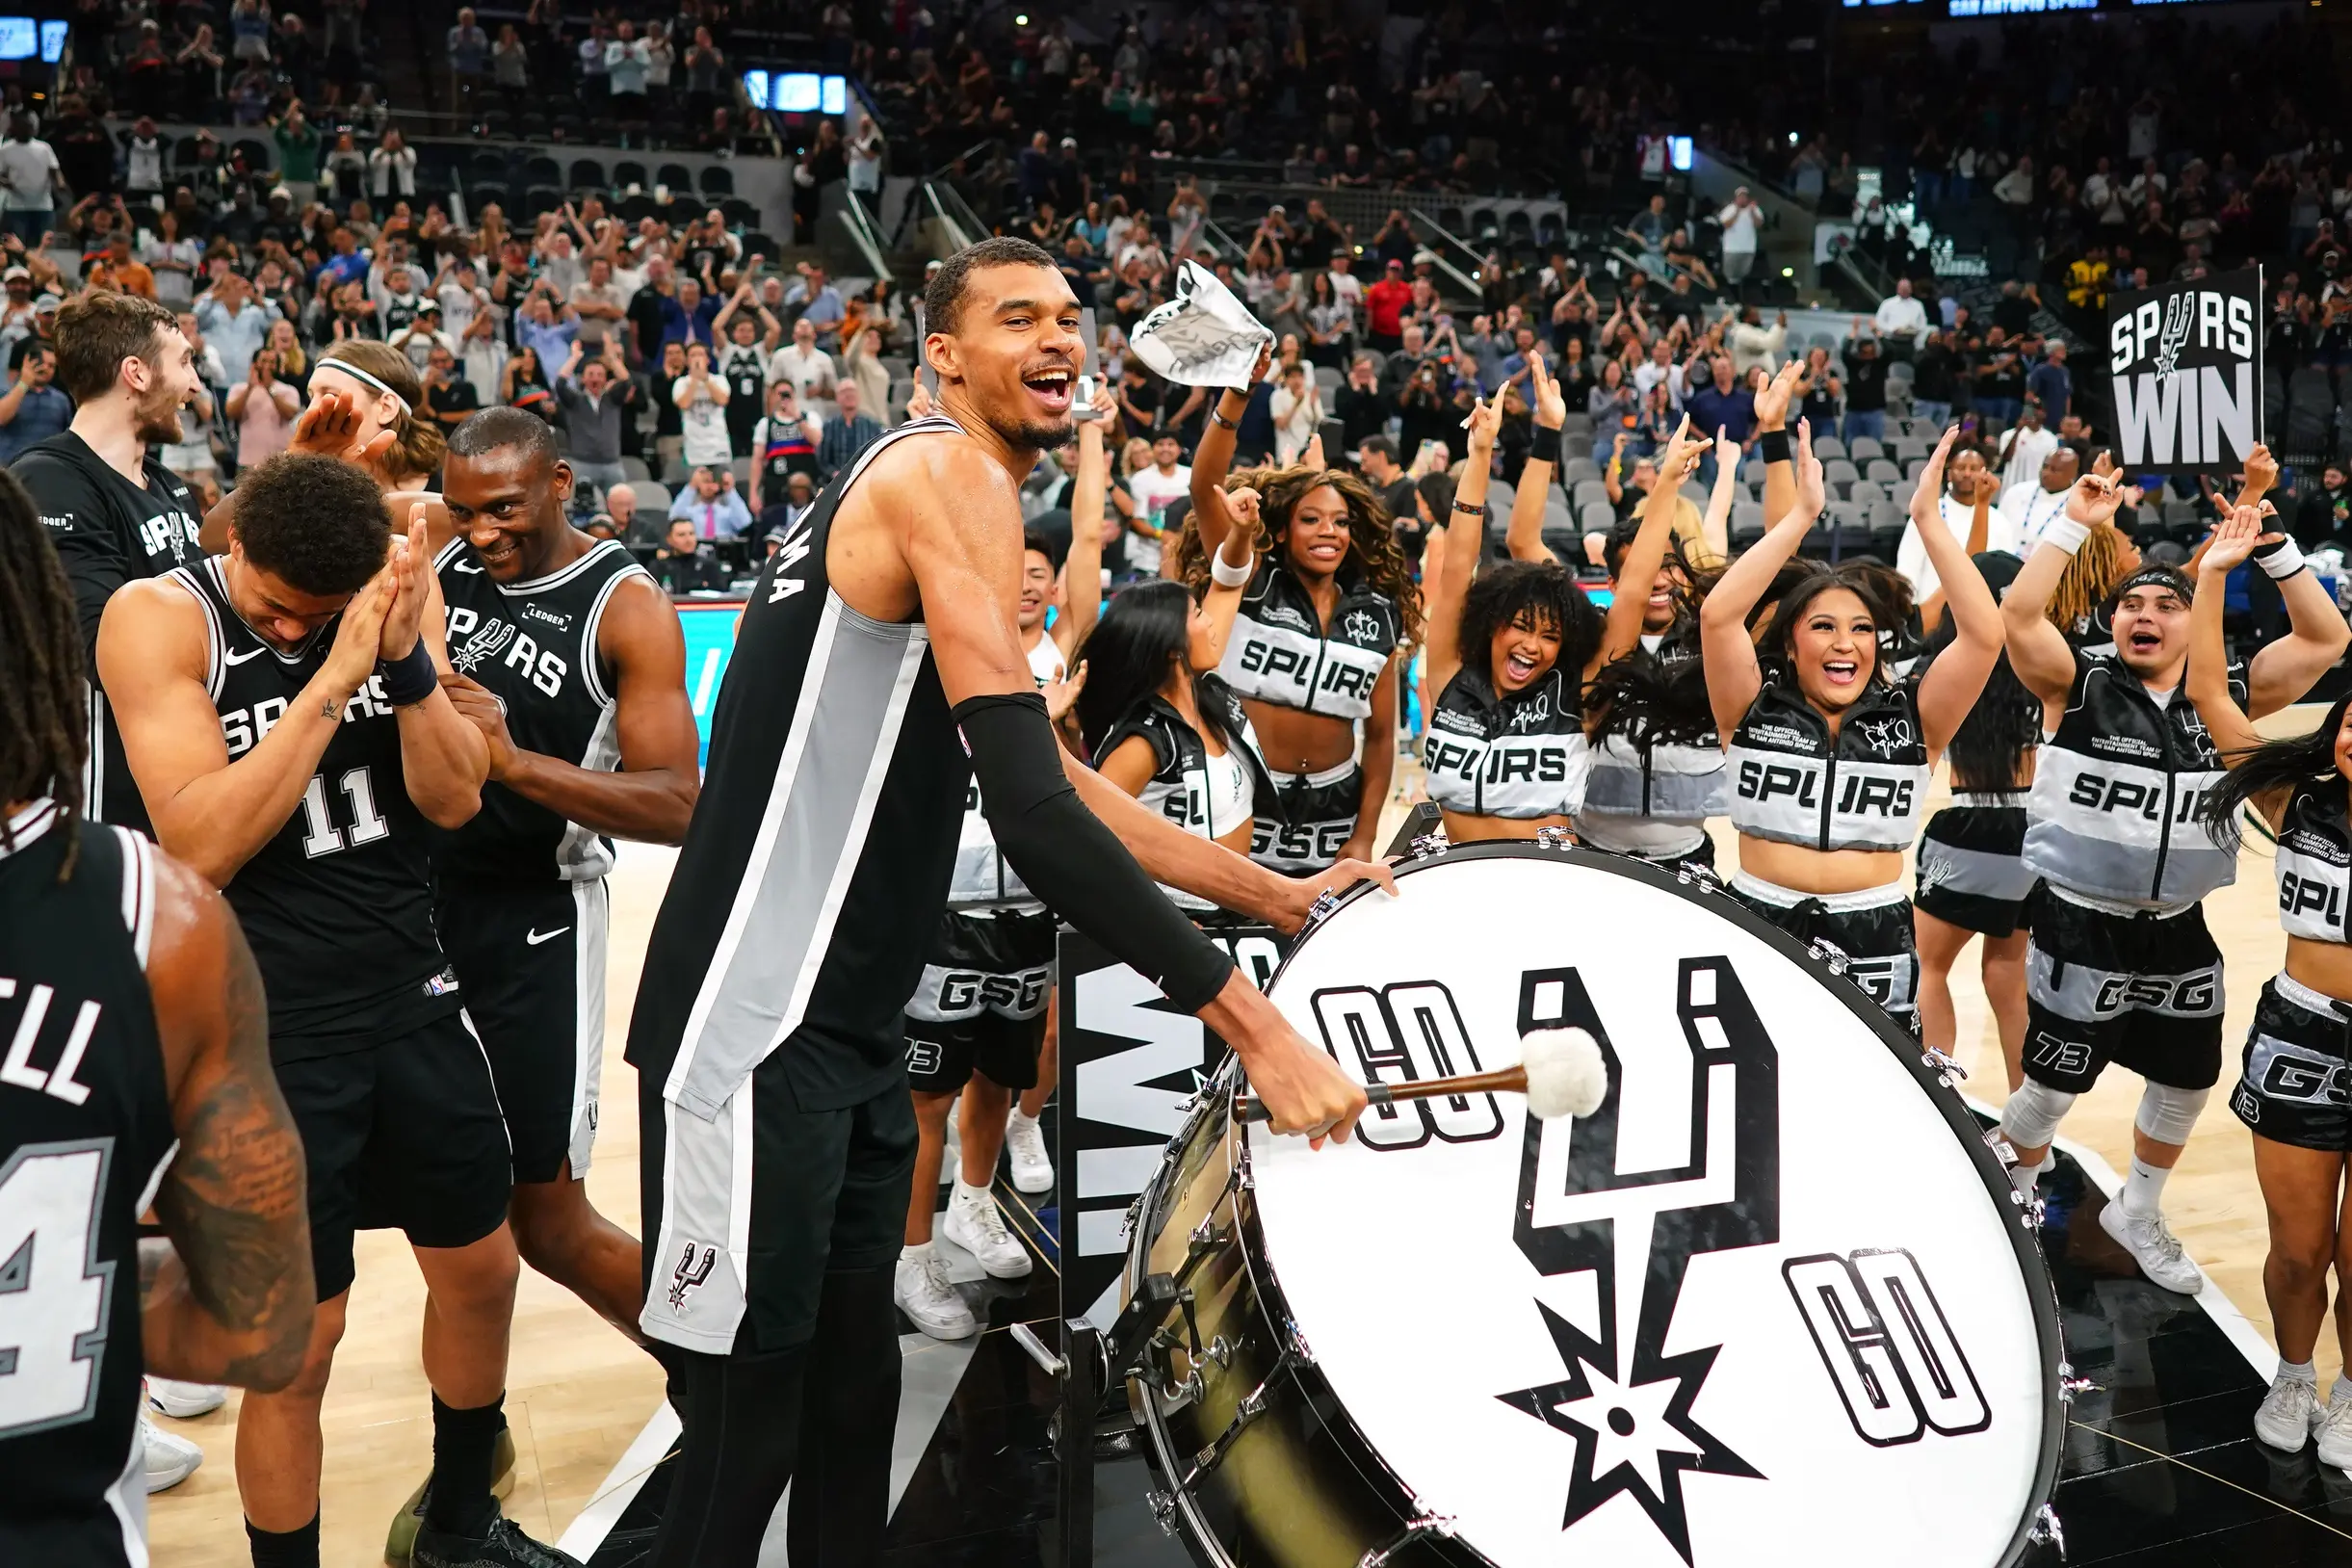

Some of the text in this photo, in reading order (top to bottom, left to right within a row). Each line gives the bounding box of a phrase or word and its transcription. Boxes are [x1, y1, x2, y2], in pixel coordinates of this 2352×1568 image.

[2111, 291, 2253, 387] SPURS
[2112, 362, 2255, 465] WIN
[529, 607, 565, 626] LEDGER
[445, 605, 567, 699] PURS
[1241, 639, 1376, 701] SPURS
[1756, 734, 1768, 743] SAN
[1767, 737, 1794, 746] ANTONIO
[1794, 742, 1816, 751] SPURS
[1762, 723, 1801, 737] THE OFFICIAL
[1791, 735, 1809, 745] TEAM
[2116, 746, 2142, 756] ANTONIO
[2121, 737, 2148, 747] OFFICIAL
[2139, 745, 2156, 753] TEAM
[1425, 736, 1566, 784] SPURS
[1738, 760, 1915, 818] SPURS
[301, 766, 390, 859] 11
[2300, 829, 2339, 850] THE OFFICIAL
[2302, 844, 2329, 858] ANTONIO
[2328, 849, 2346, 858] TEAM
[938, 967, 1049, 1014] GSG
[2094, 971, 2216, 1015] GSG
[0, 977, 102, 1107] LL
[2032, 1031, 2092, 1075] 73
